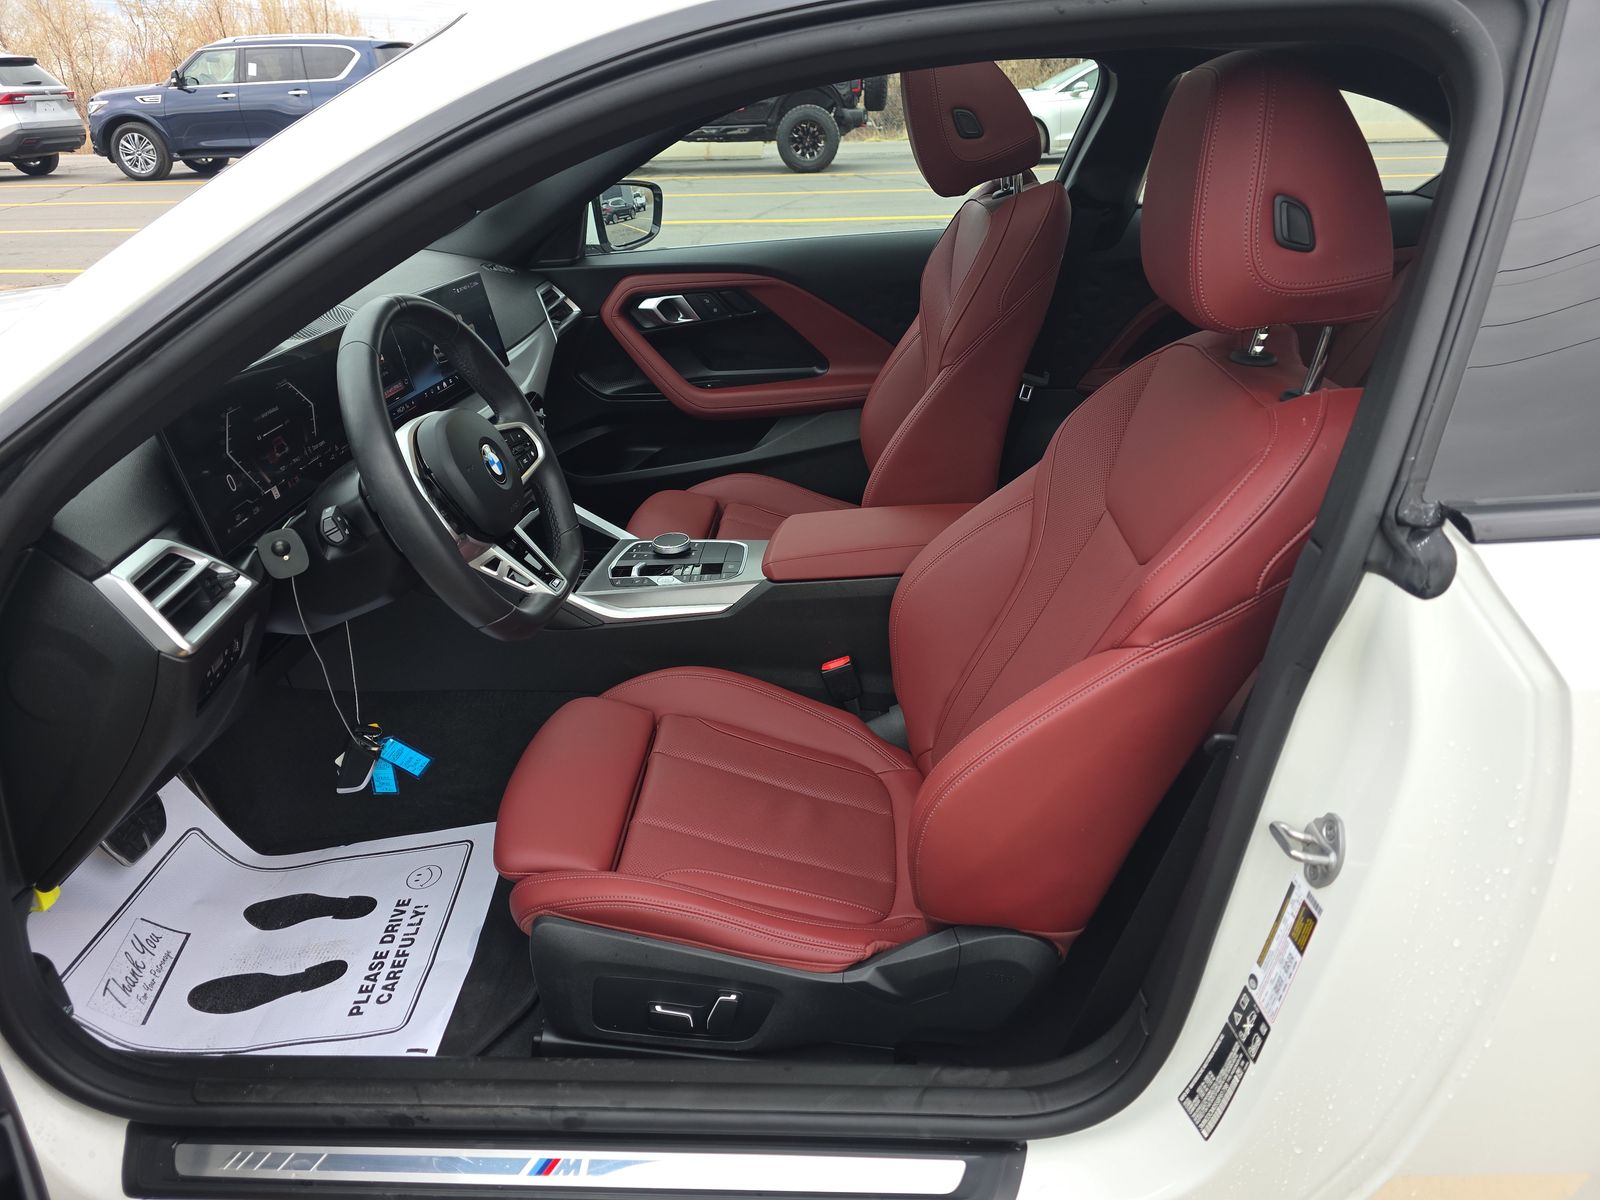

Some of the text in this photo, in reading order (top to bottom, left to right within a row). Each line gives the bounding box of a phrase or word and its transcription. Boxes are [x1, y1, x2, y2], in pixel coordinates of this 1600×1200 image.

[103, 932, 163, 1008] Thank You
[136, 949, 174, 1005] For Your Patronage
[347, 898, 412, 1017] PLEASE DRIVE
[375, 904, 429, 1005] CAREFULLY!
[552, 1158, 583, 1177] M
